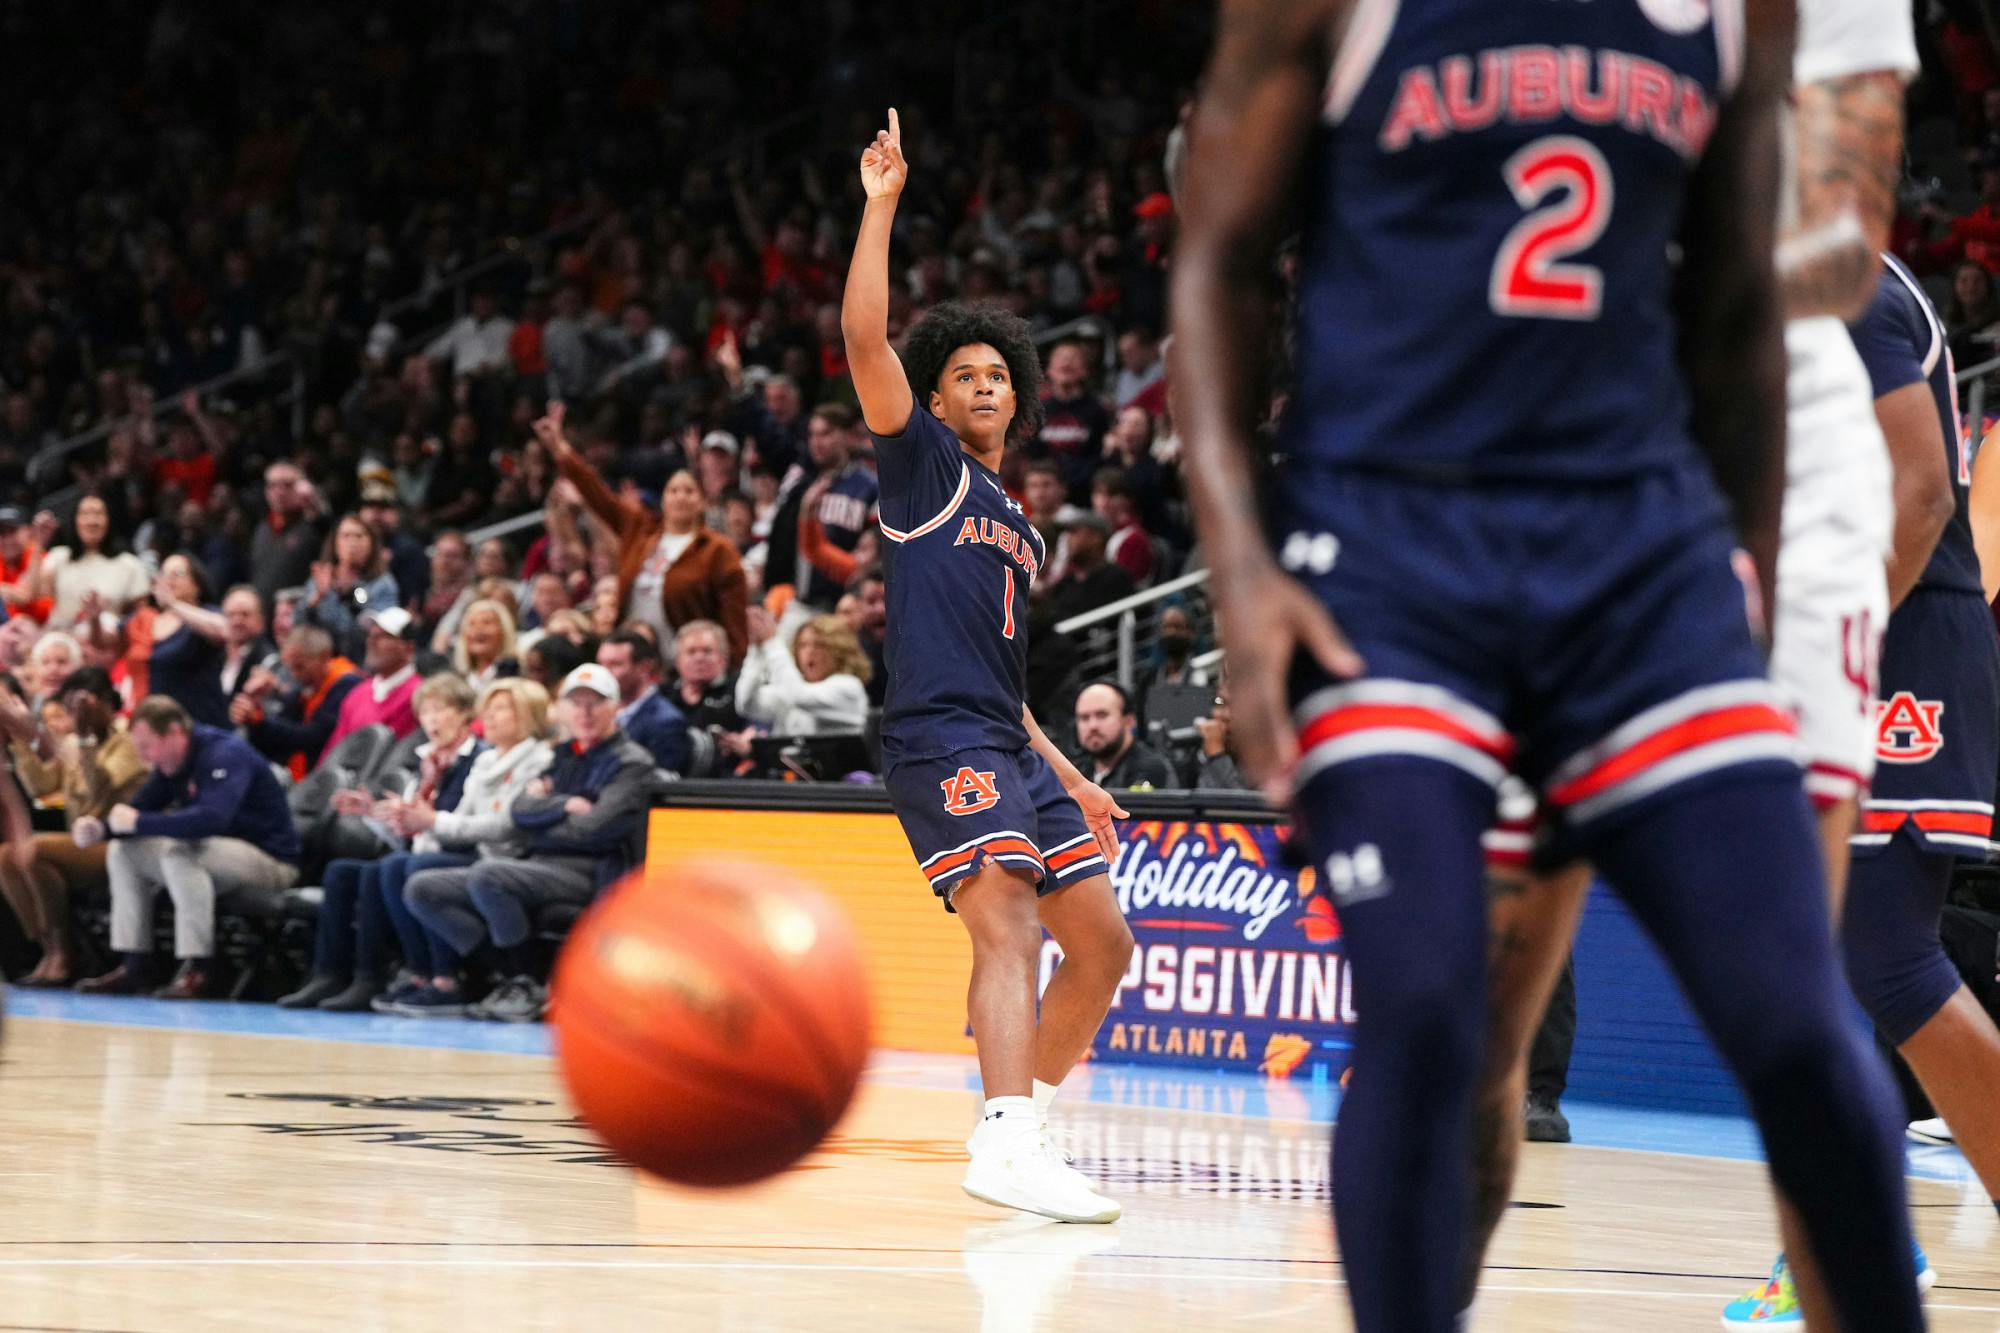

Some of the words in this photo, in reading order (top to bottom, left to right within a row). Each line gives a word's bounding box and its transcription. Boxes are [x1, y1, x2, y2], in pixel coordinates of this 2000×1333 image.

[1489, 135, 1614, 320] 2
[954, 516, 1038, 588] AUBUR
[1003, 565, 1015, 640] 1
[1108, 839, 1290, 941] Holiday
[1109, 1023, 1247, 1059] ATLANTA
